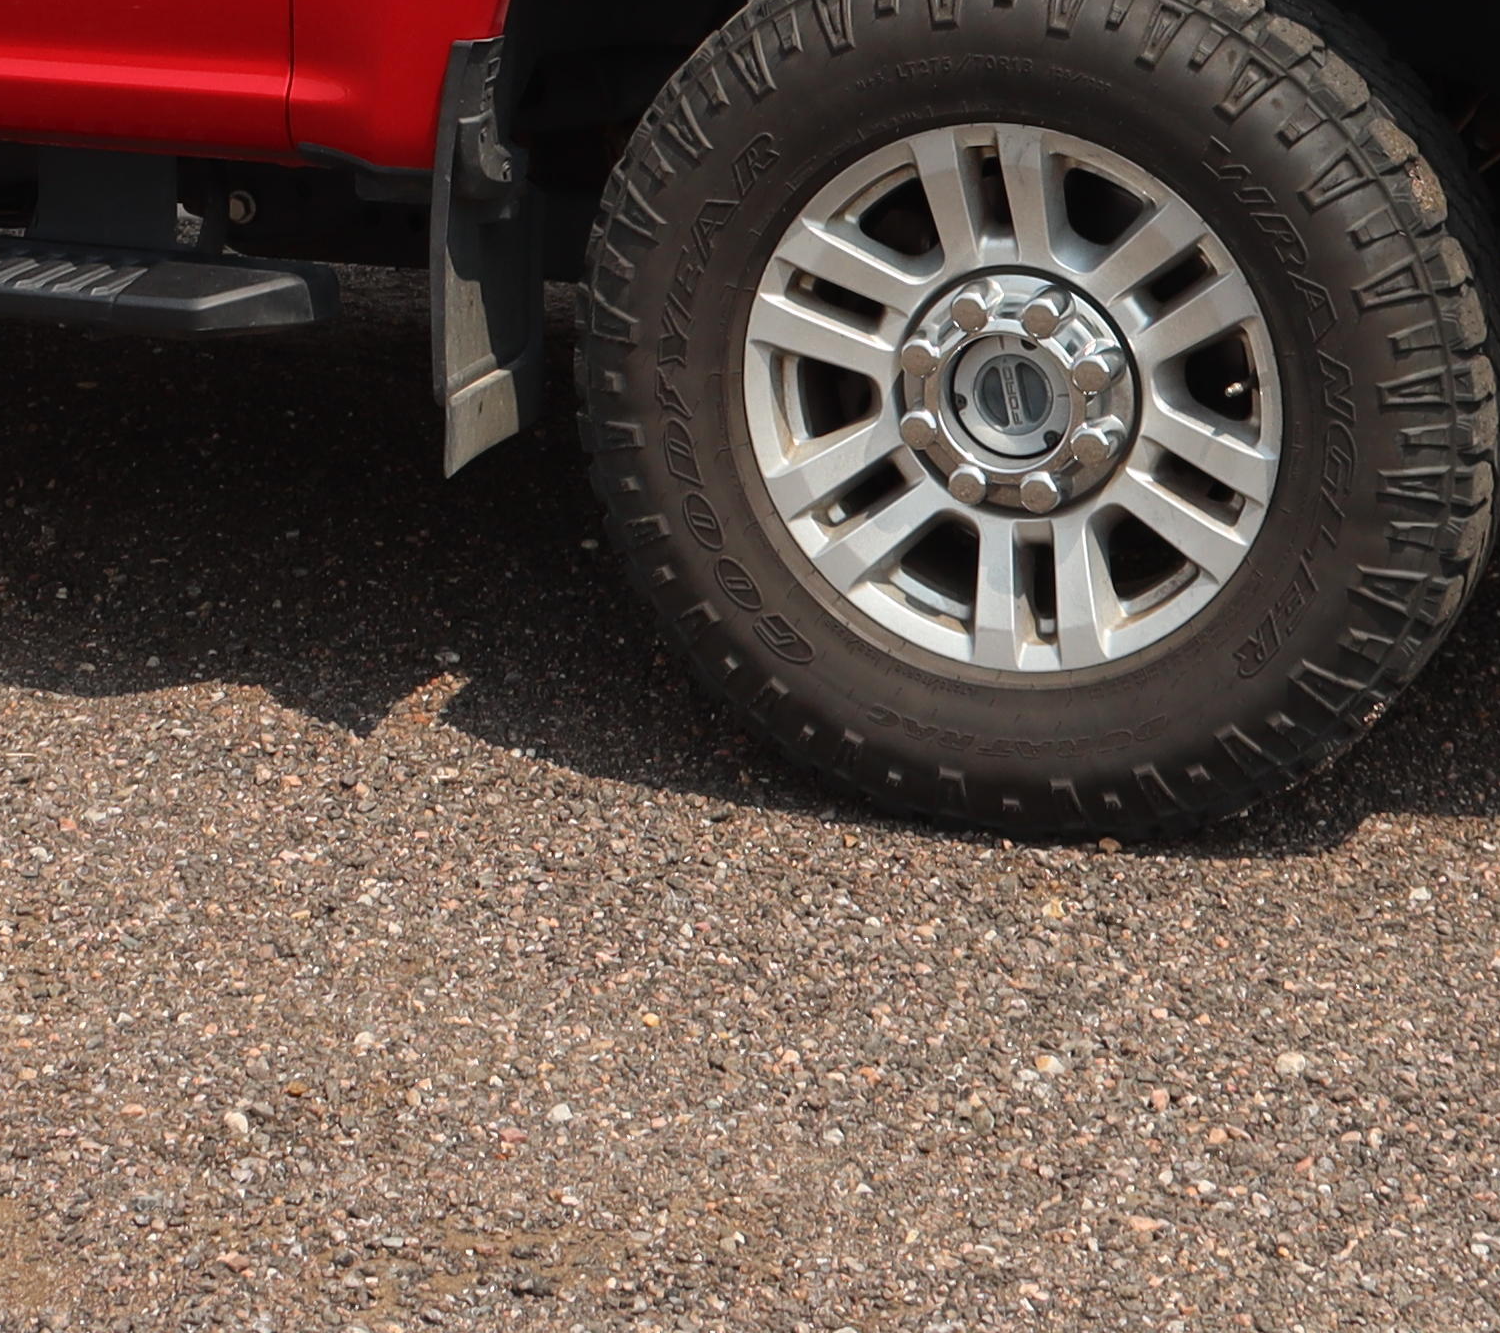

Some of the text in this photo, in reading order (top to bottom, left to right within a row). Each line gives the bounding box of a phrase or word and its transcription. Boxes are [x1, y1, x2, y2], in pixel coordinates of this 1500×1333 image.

[656, 133, 816, 664] GOODYEAR
[1001, 365, 1024, 426] FORD
[1202, 135, 1360, 679] WRANGLER
